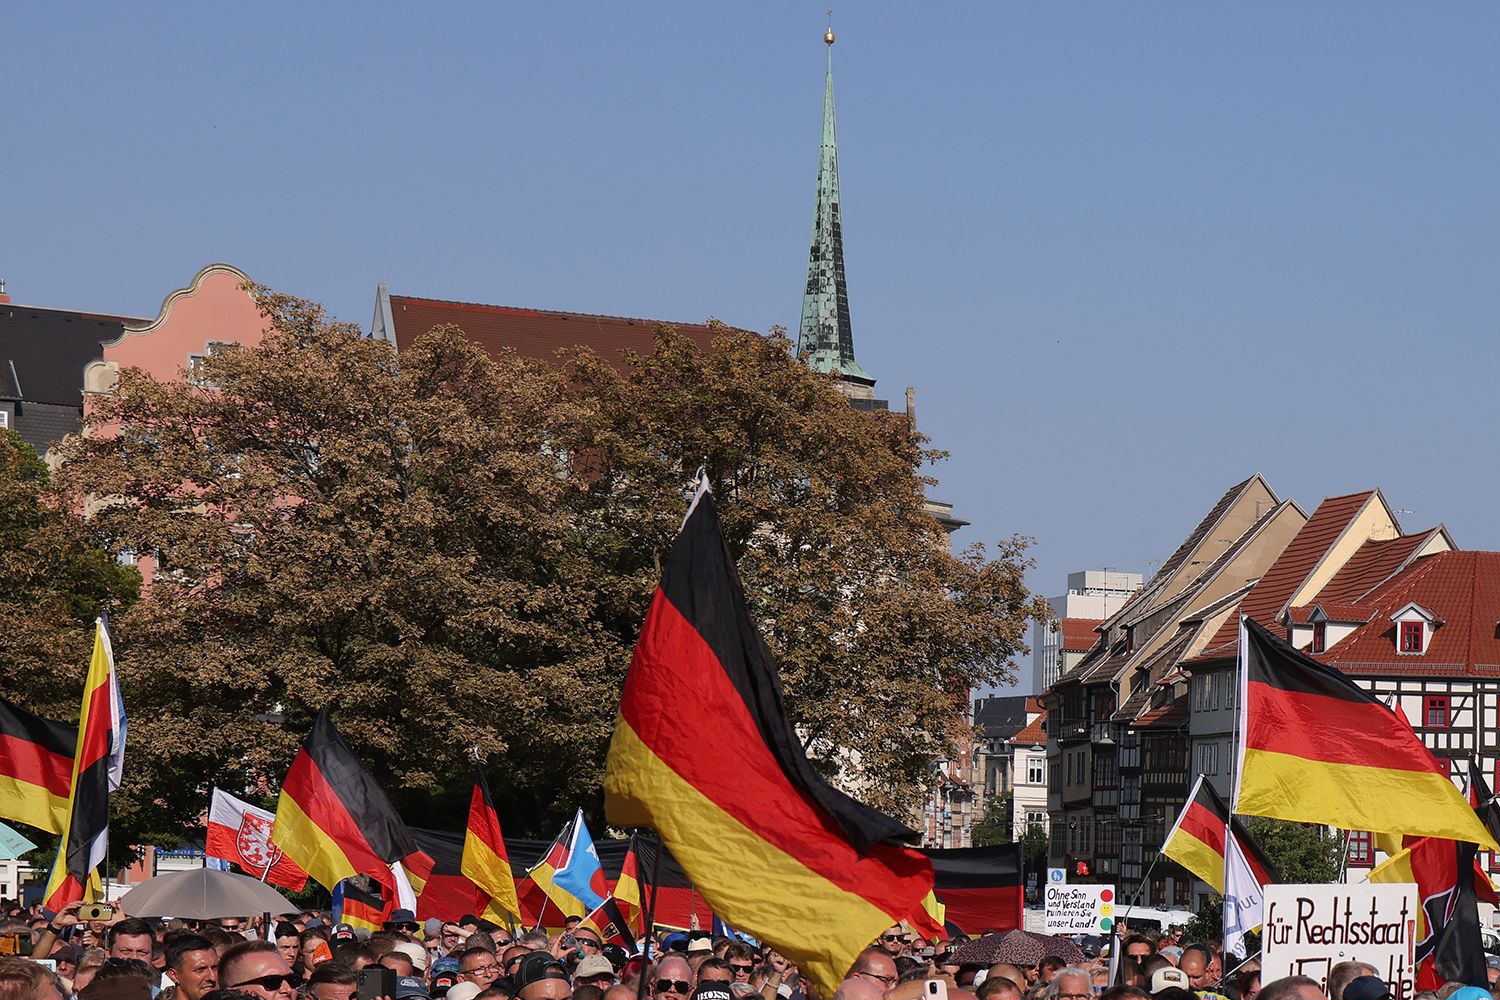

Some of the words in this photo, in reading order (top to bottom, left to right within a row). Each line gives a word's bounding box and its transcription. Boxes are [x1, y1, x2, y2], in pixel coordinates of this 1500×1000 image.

[1047, 888, 1071, 901] Ohne
[1062, 899, 1096, 910] Verstand
[1266, 902, 1293, 954] für
